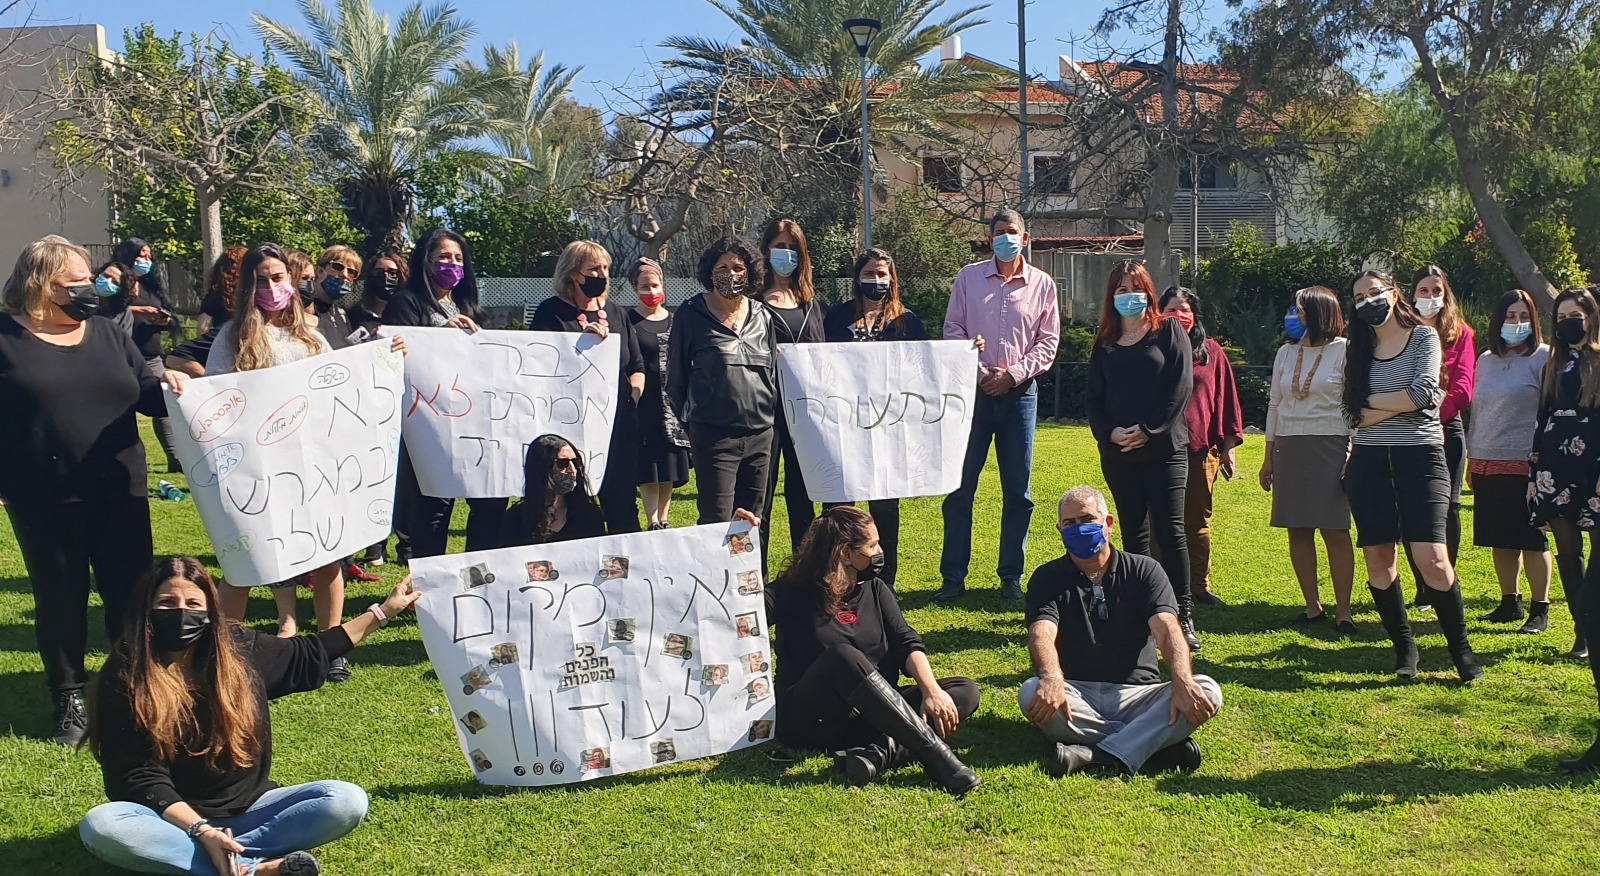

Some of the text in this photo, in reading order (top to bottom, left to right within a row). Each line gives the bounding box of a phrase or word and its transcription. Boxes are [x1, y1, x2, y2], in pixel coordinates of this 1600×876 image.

[478, 341, 606, 384] גבר
[327, 363, 396, 438] לא
[407, 373, 610, 425] אמיתי לא
[459, 435, 501, 467] יד
[226, 446, 394, 515] במגרש
[266, 508, 345, 566] שלי
[452, 568, 732, 671] אין מקום
[564, 656, 609, 673] הפנים
[575, 643, 596, 657] כל
[563, 667, 616, 687] והשמות
